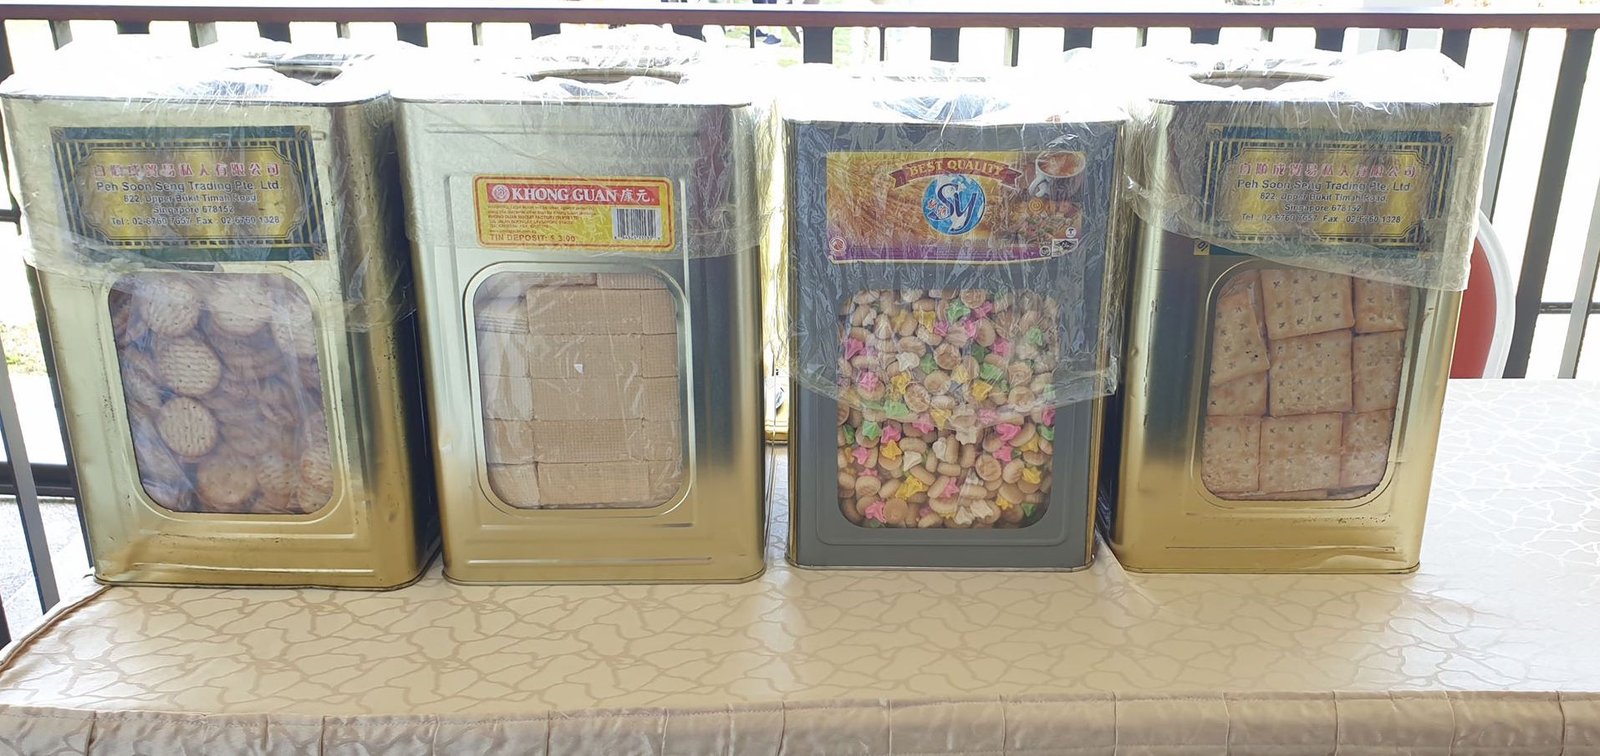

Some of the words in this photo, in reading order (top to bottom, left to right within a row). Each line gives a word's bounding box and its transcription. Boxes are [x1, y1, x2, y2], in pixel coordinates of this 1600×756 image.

[909, 161, 944, 176] BEST
[947, 160, 1004, 175] QUALITY
[96, 181, 118, 191] Peh
[122, 181, 152, 191] Soon
[155, 181, 185, 192] Seng
[187, 180, 232, 192] Trading
[1237, 180, 1258, 189] Peh
[1262, 180, 1290, 189] Soon
[1294, 180, 1321, 191] Seng
[1326, 181, 1366, 191] Trading
[145, 194, 173, 204] Upper
[202, 194, 230, 202] Timah
[512, 187, 569, 201] KHONG
[572, 188, 617, 202] GUAN
[620, 188, 650, 202] 康元
[1309, 193, 1332, 201] Bukit
[153, 207, 199, 215] Singapore
[1285, 203, 1328, 212] Singapore
[197, 216, 213, 224] Fax
[1382, 215, 1401, 223] 1328
[506, 234, 548, 242] DEPOSIT:
